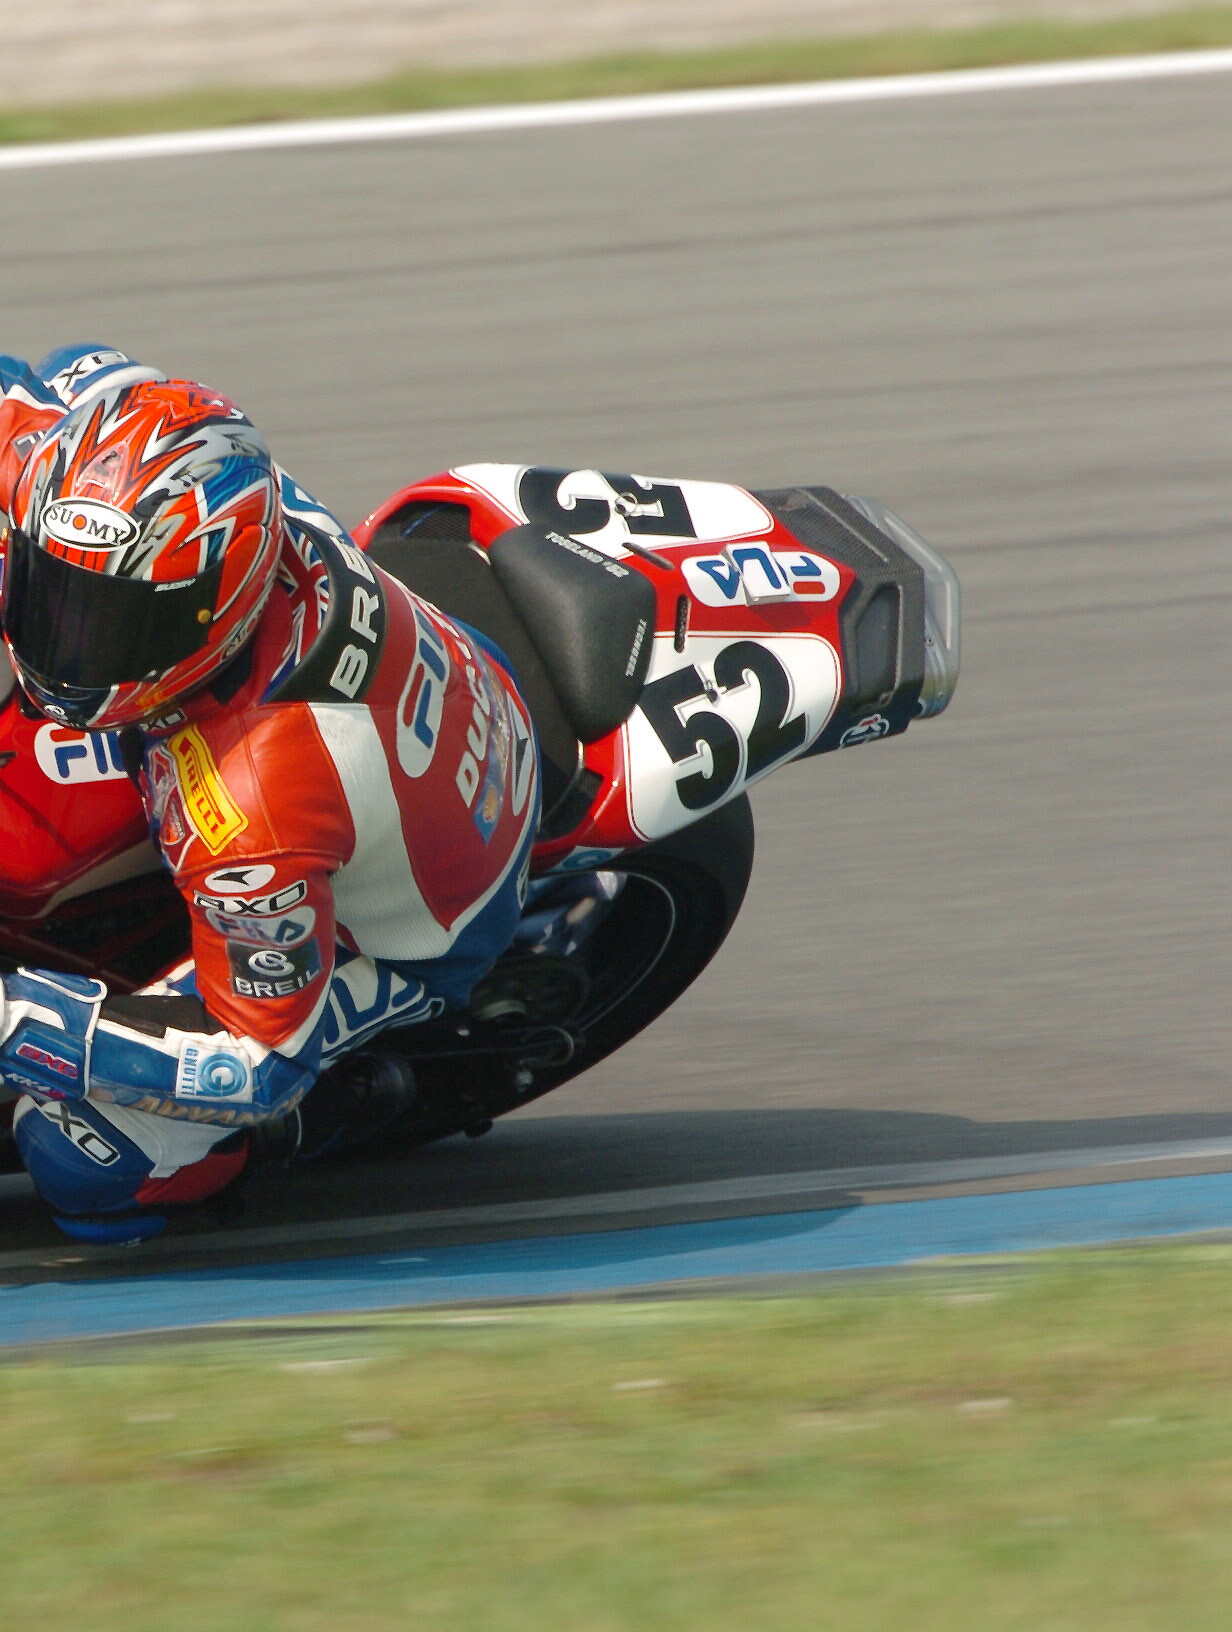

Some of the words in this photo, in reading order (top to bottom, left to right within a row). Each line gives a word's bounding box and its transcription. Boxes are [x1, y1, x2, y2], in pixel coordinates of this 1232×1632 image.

[49, 505, 127, 545] SUOMY
[696, 547, 825, 600] FLA
[642, 640, 806, 811] 52
[179, 737, 226, 836] PIRELLI
[196, 881, 306, 914] AXO
[234, 969, 320, 997] BREIL
